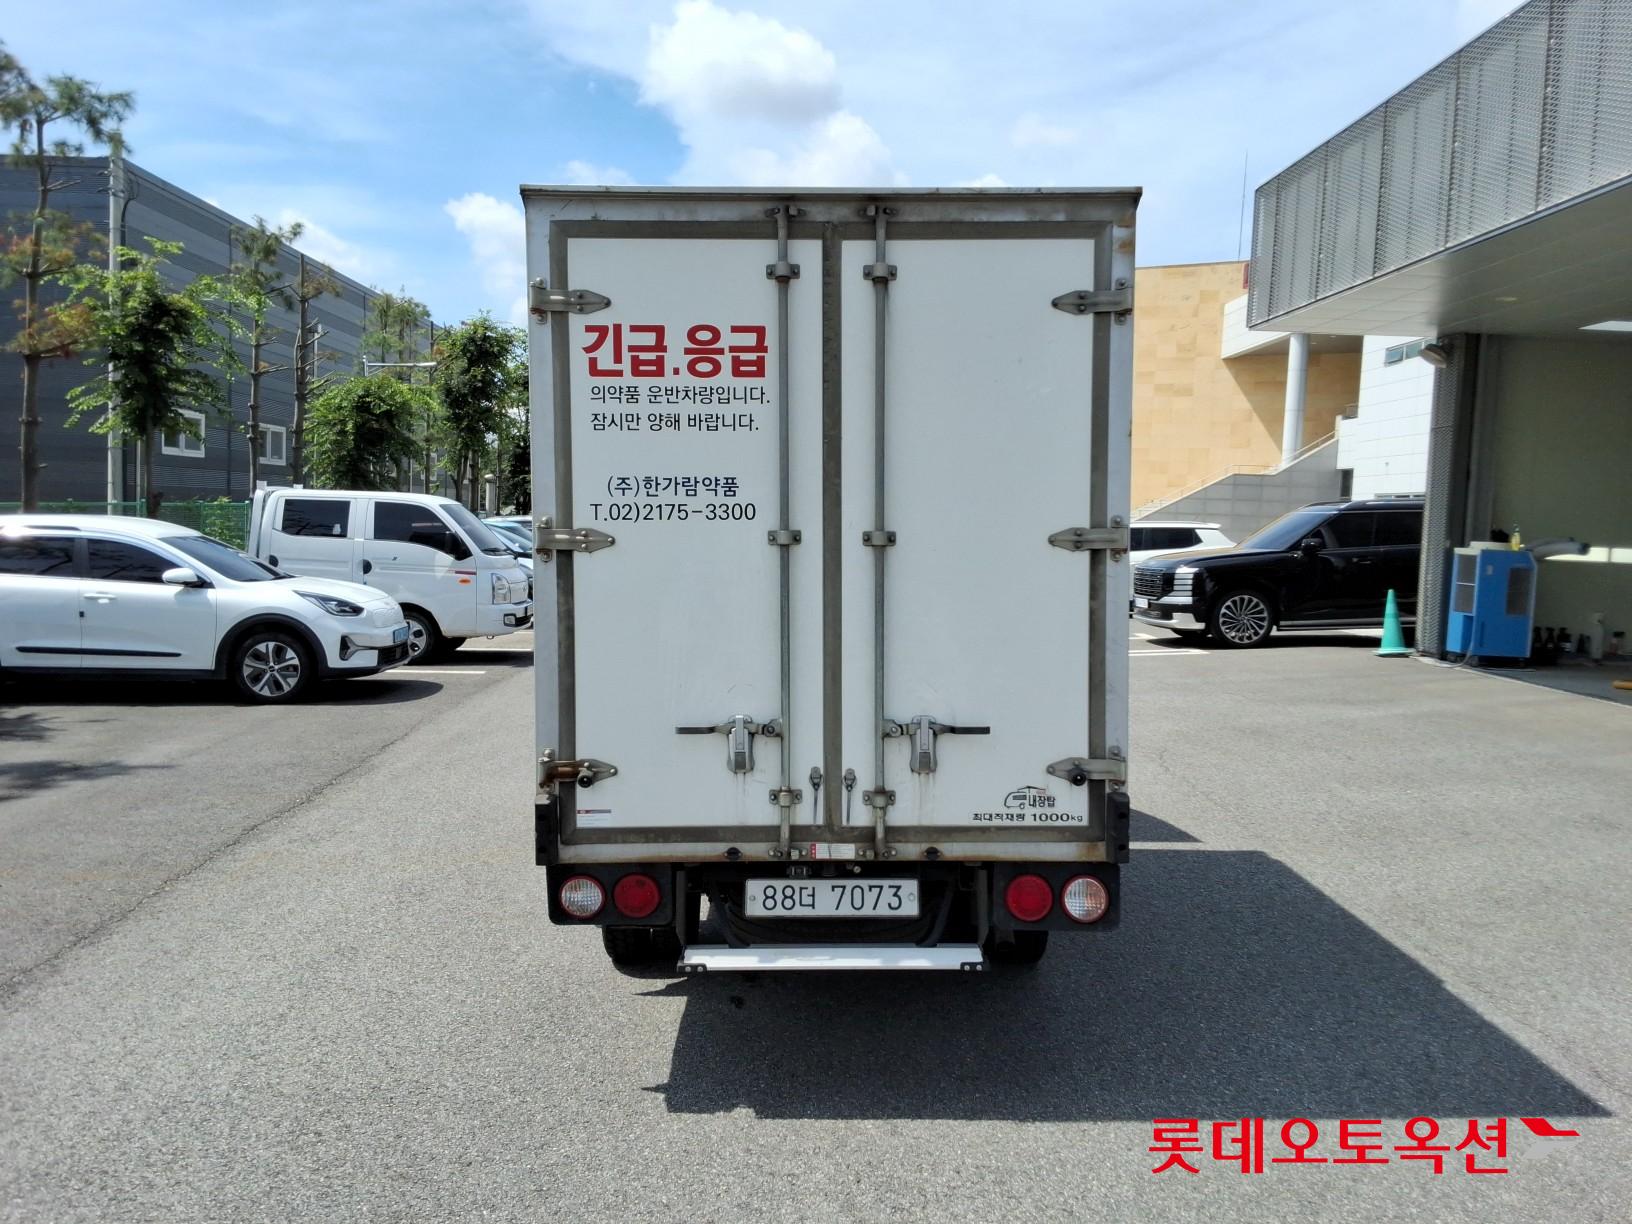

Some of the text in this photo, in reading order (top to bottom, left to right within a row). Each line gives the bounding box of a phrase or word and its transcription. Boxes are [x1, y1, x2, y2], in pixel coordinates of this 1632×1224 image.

[582, 323, 769, 379] 긴급.응급
[590, 385, 771, 405] 의약품 운반차량입니다.
[590, 412, 759, 432] 잠시만 양해 바랍니다.
[607, 475, 740, 498] (주)한가람약품
[590, 502, 757, 524] T.02)2175-3300
[762, 884, 903, 912] 88더 7073
